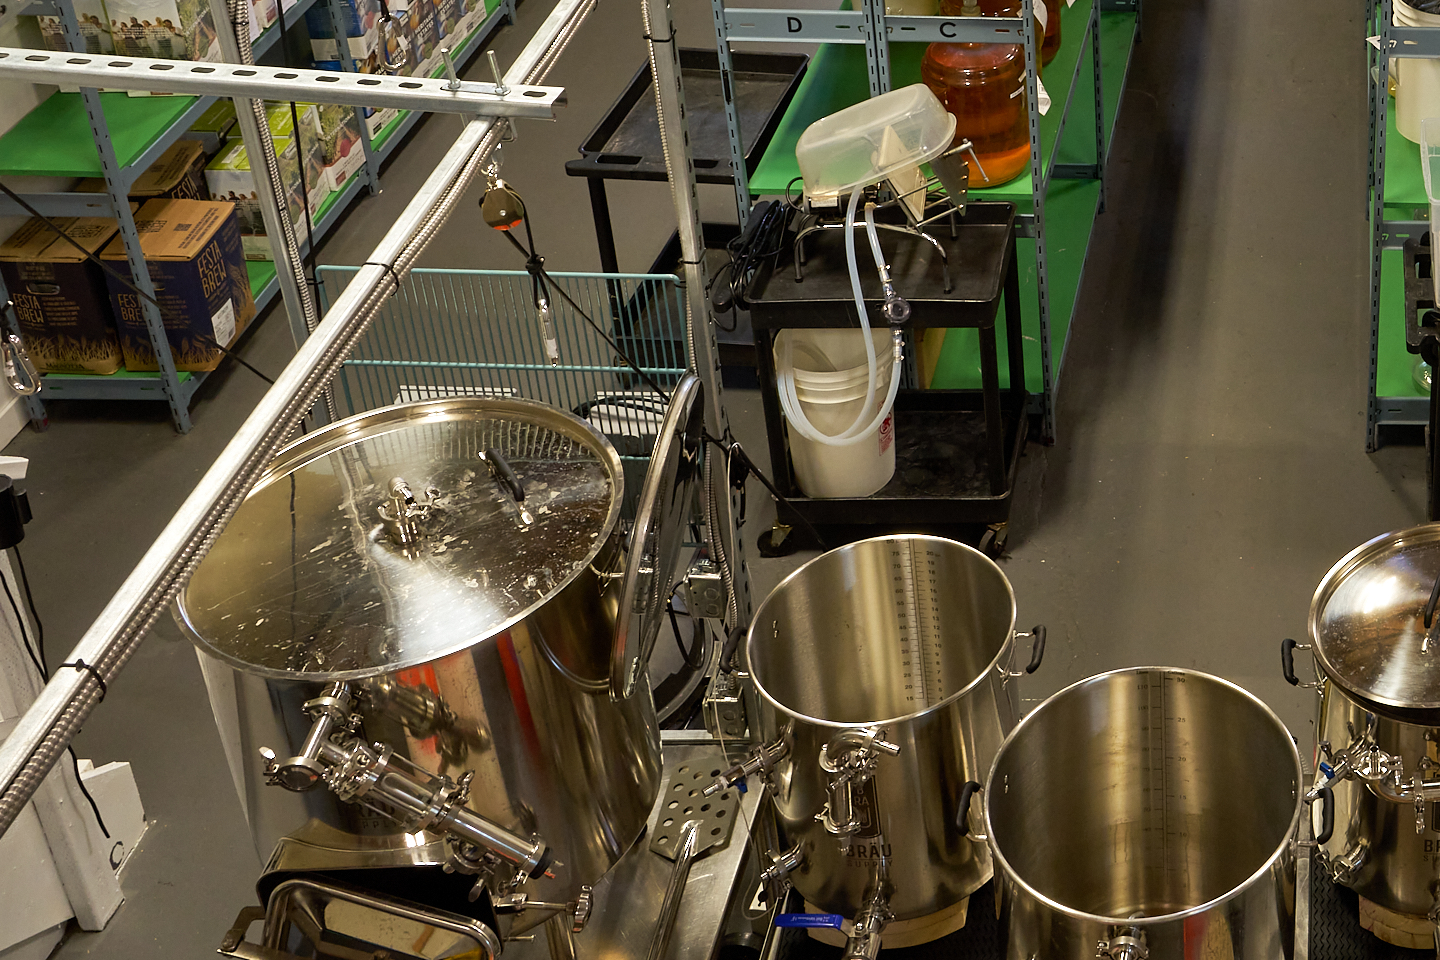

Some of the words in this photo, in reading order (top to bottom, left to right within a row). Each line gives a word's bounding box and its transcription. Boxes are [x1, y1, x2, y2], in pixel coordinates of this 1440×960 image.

[414, 12, 434, 34] HERITAGE
[417, 20, 434, 40] ESTATES
[787, 16, 803, 33] D
[939, 21, 957, 38] C
[197, 240, 223, 279] FESTA
[202, 259, 227, 299] BREW
[13, 293, 41, 310] FESTA
[118, 293, 142, 308] FEST
[17, 306, 44, 323] BREW
[121, 307, 145, 321] BRE
[846, 842, 893, 859] BRÄU
